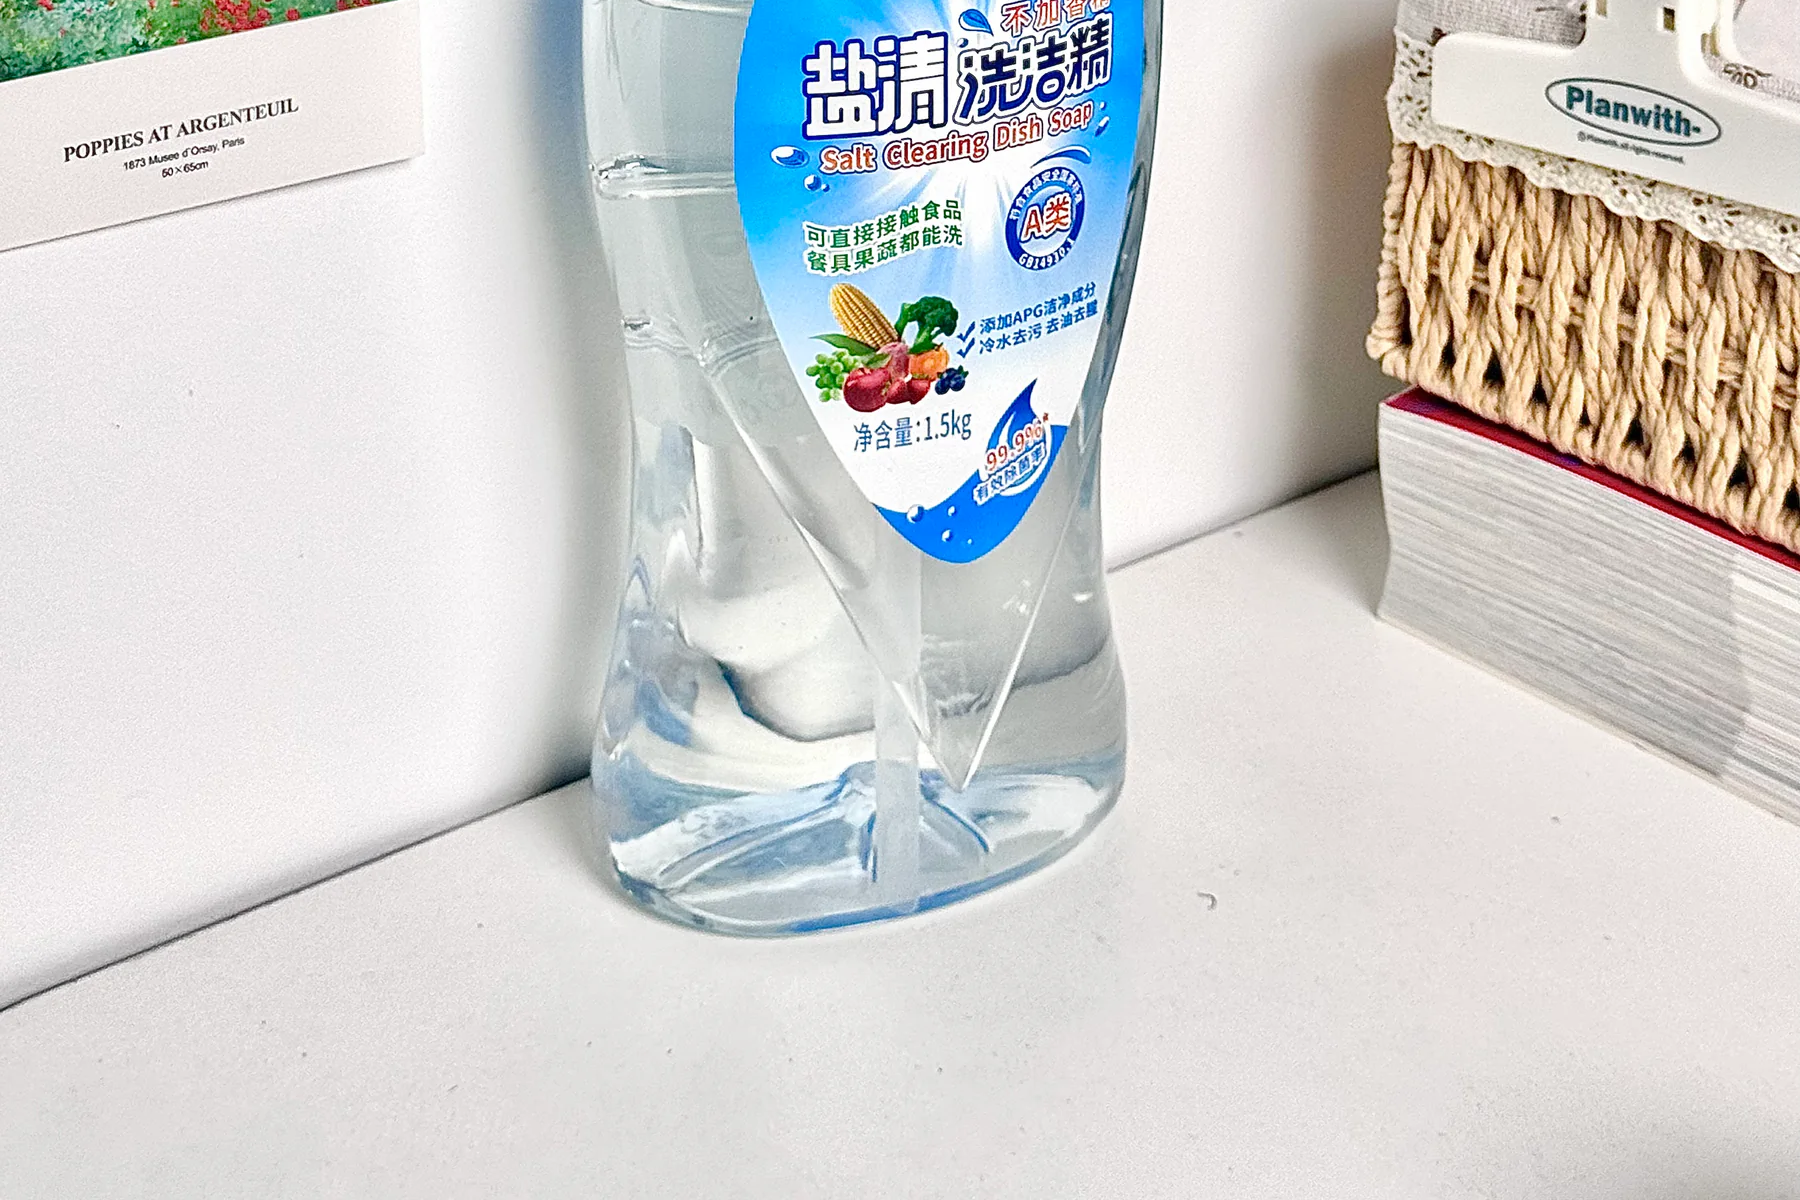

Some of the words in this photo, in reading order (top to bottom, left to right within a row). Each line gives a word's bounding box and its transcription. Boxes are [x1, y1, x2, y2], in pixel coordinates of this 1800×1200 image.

[802, 31, 949, 140] 盐清
[955, 16, 1113, 120] 洗洁精
[63, 131, 144, 162] POPPIES
[148, 125, 173, 144] AT
[177, 98, 299, 138] ARGENTEUIL
[123, 158, 146, 171] 1873
[222, 137, 245, 148] Paris
[822, 147, 876, 171] Salt
[886, 132, 987, 165] Clearing
[996, 114, 1041, 148] Dish
[1050, 102, 1092, 133] Soap
[805, 200, 963, 248] 可直接接触食品
[1023, 196, 1070, 238] A类
[807, 224, 963, 273] 餐具果蔬都能洗
[979, 281, 1097, 335] 添加APG洁净成分
[979, 323, 1042, 354] 冷水去污
[976, 444, 1042, 501] 有效除菌率
